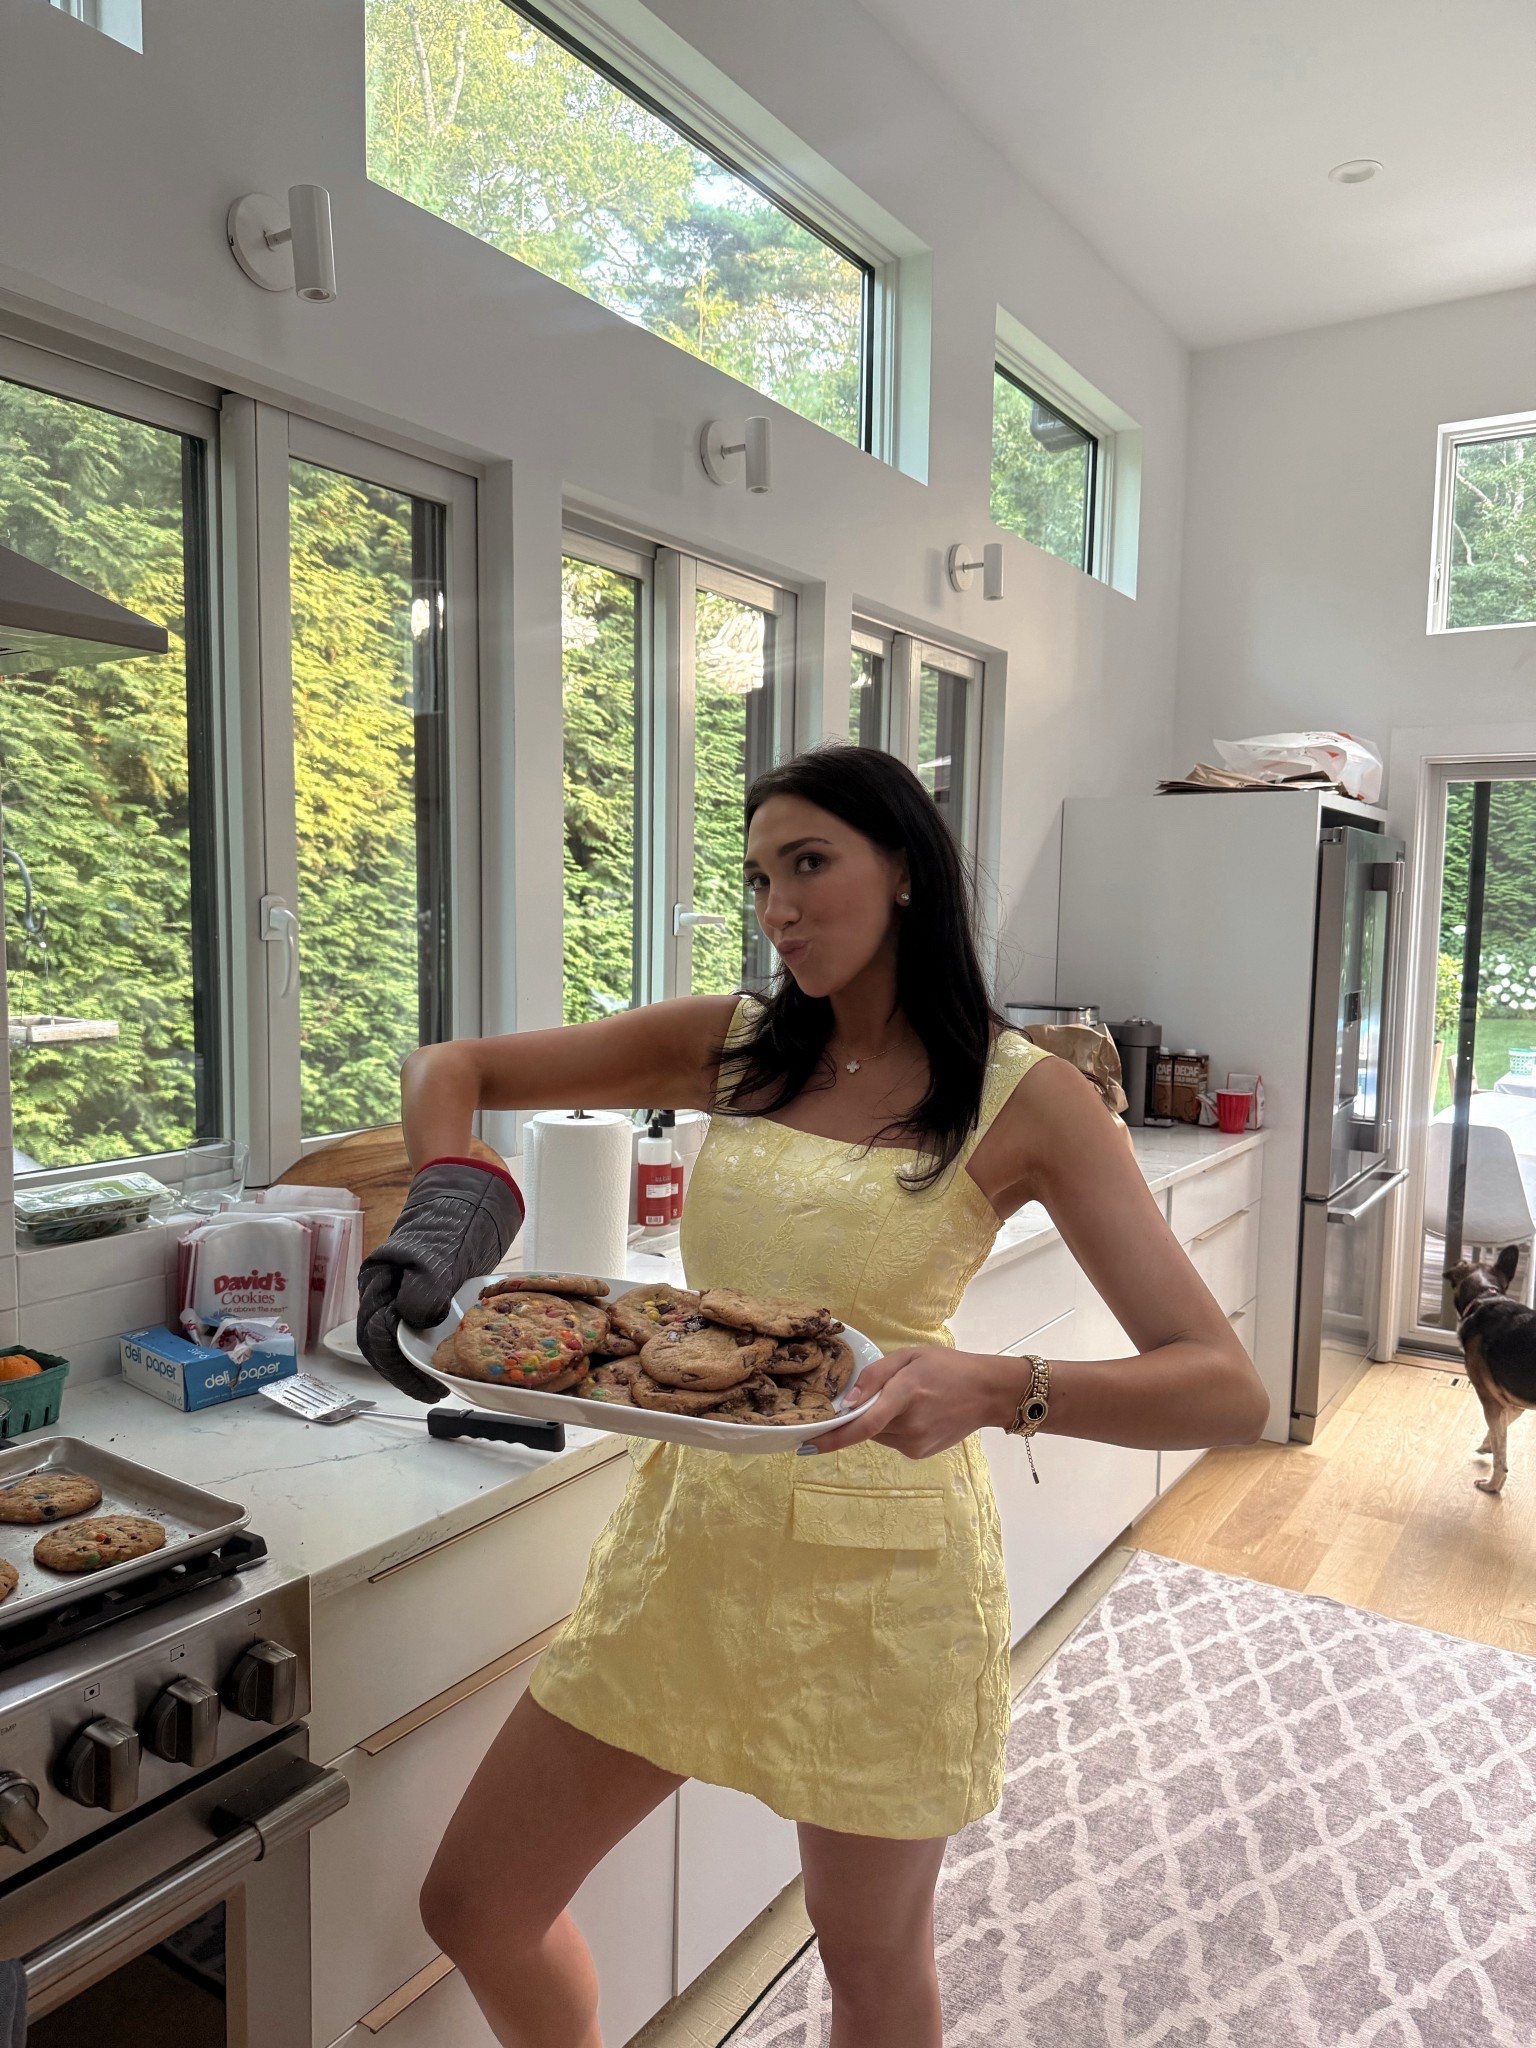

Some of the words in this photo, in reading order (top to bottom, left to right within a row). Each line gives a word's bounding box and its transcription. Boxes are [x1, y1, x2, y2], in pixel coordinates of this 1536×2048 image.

[1174, 1065, 1200, 1077] DECAF
[214, 1269, 287, 1295] David's
[221, 1291, 276, 1305] Cookies
[233, 1305, 257, 1314] above
[257, 1305, 269, 1313] the
[125, 1344, 142, 1363] deli
[146, 1355, 177, 1380] paper
[204, 1370, 230, 1389] deli
[239, 1362, 281, 1381] paper
